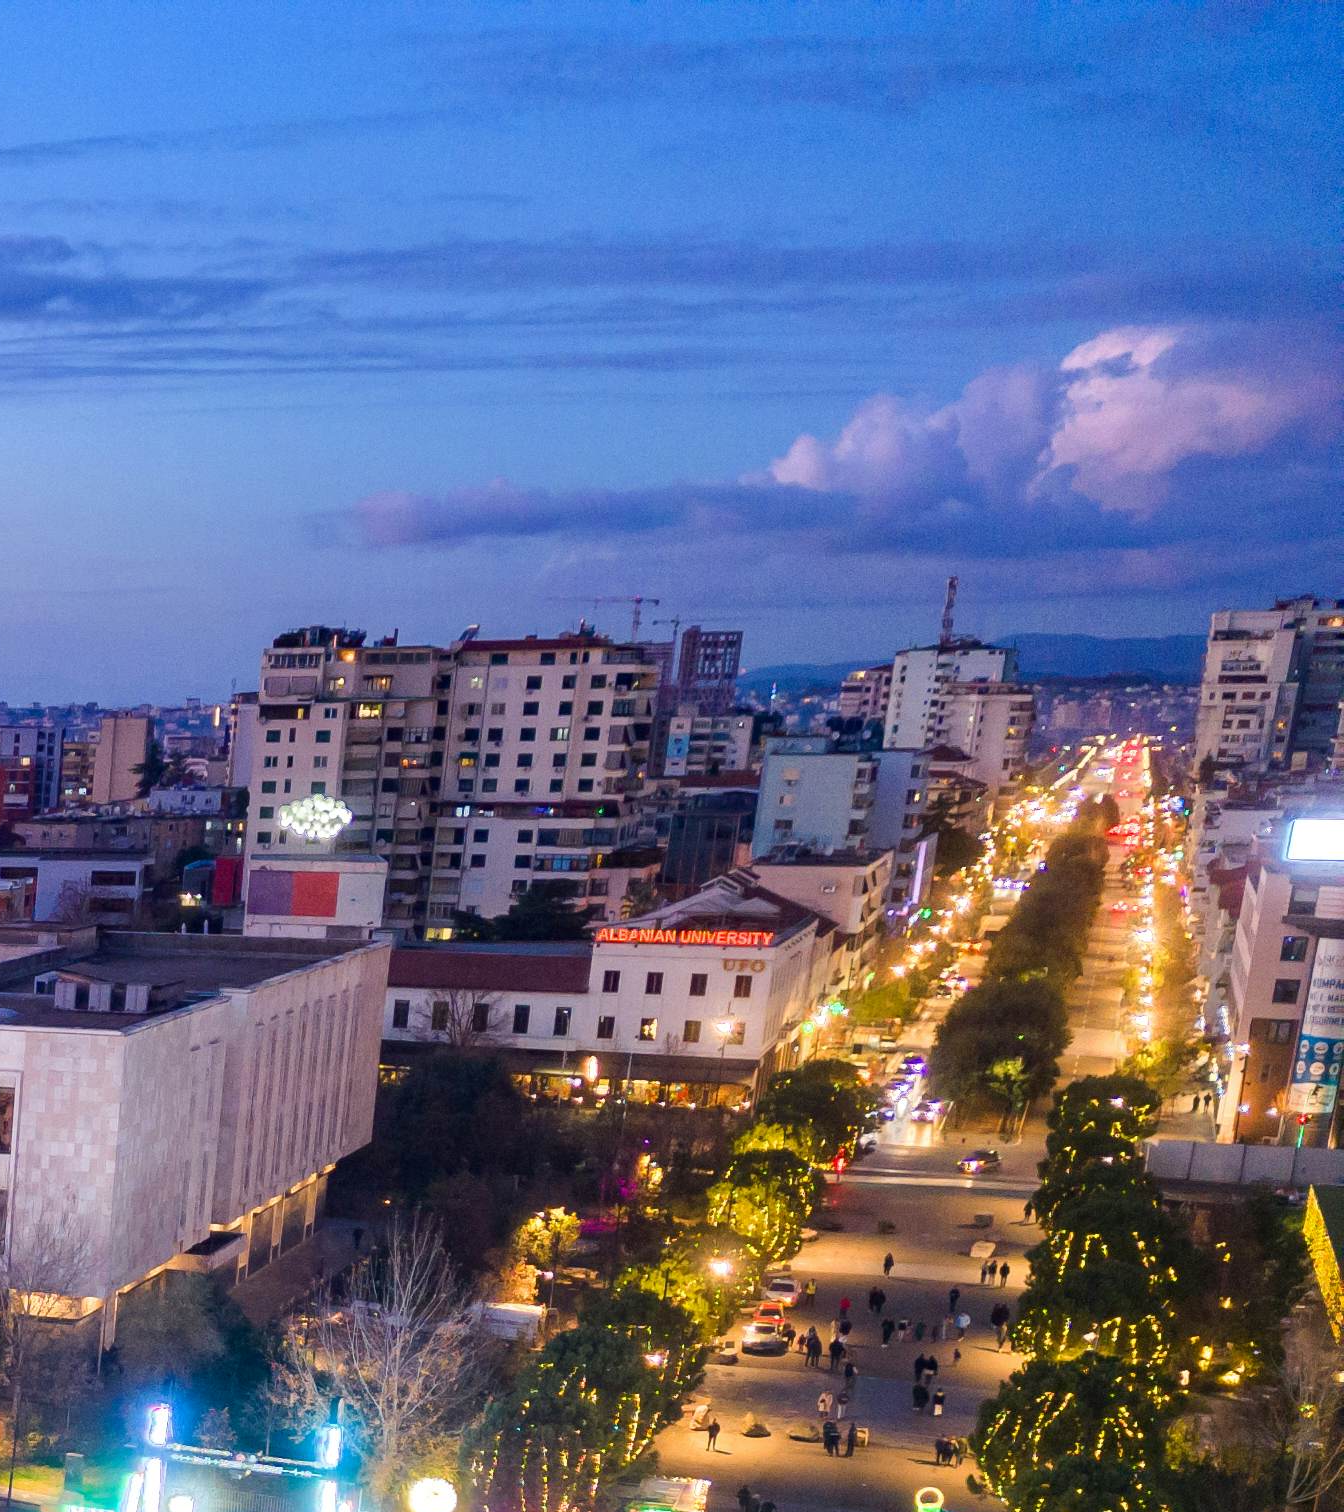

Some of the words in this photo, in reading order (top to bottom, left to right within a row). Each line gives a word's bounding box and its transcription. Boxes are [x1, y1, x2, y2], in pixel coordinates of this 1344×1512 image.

[597, 928, 677, 944] ALBANIAN
[679, 929, 775, 946] UNIVERSITY
[722, 958, 766, 972] UFO
